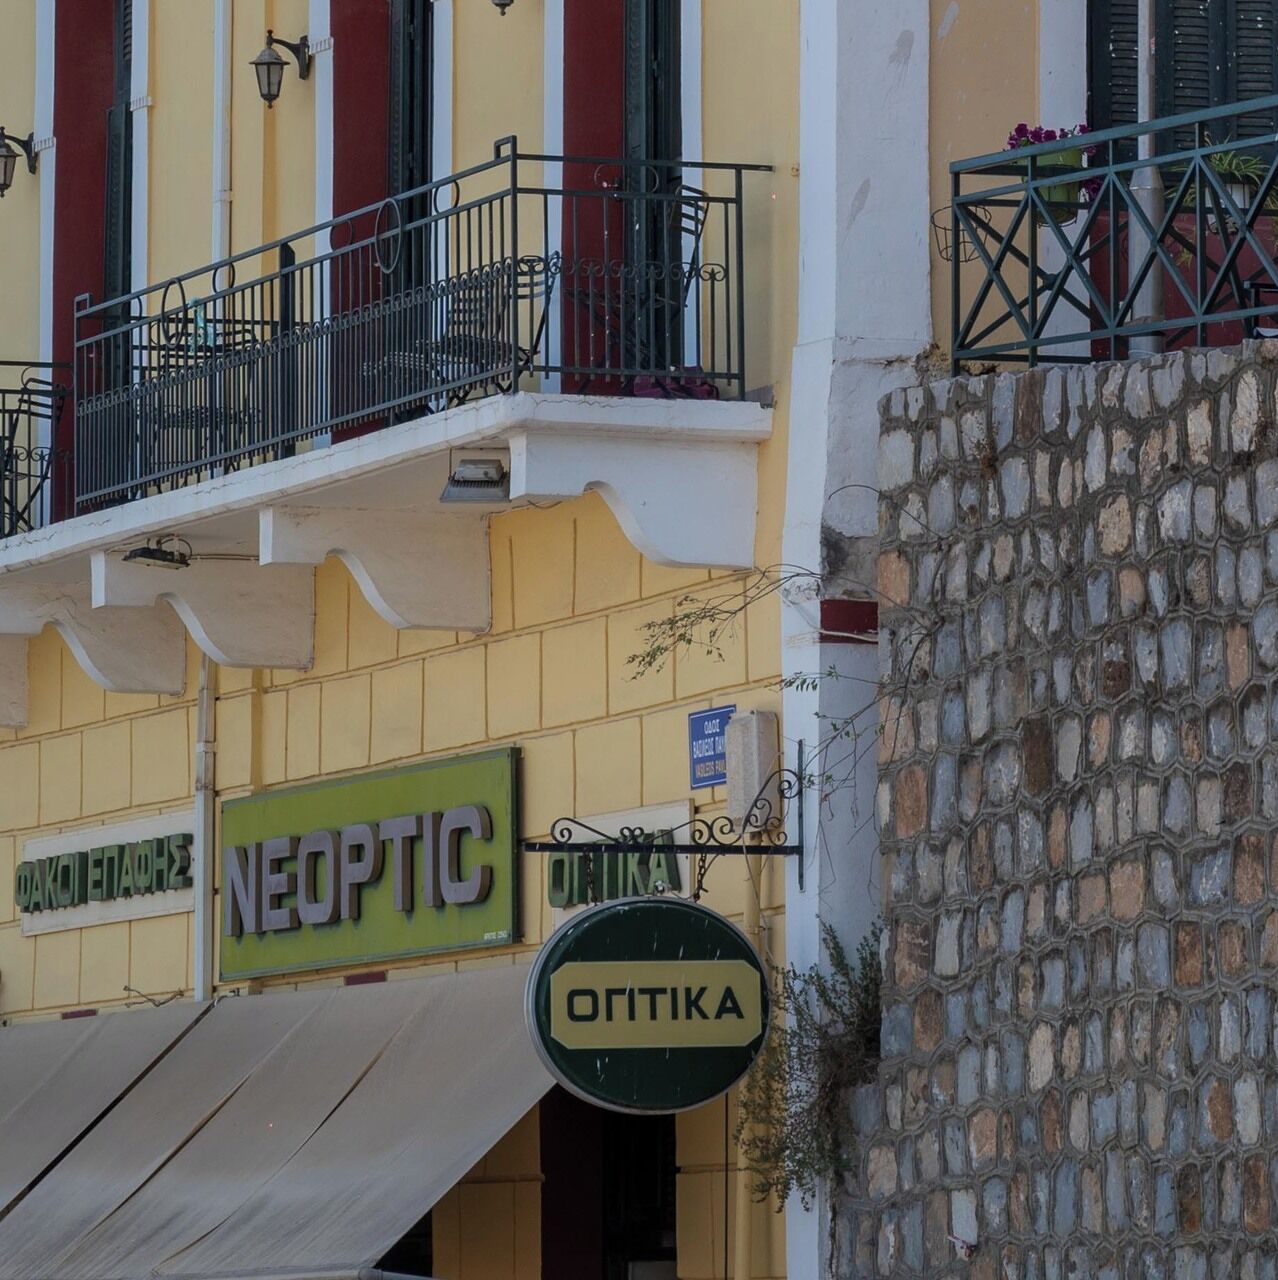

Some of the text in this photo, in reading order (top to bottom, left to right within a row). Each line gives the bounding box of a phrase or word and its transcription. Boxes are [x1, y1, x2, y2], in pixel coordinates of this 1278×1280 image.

[703, 718, 720, 734] ΟΔΟΣ
[15, 832, 194, 914] ΦΑΚΟΙ ΕΠΑΦΗΣ
[224, 804, 493, 938] NEOPTIC
[566, 985, 745, 1023] ΟΠΤΙΚΑ
